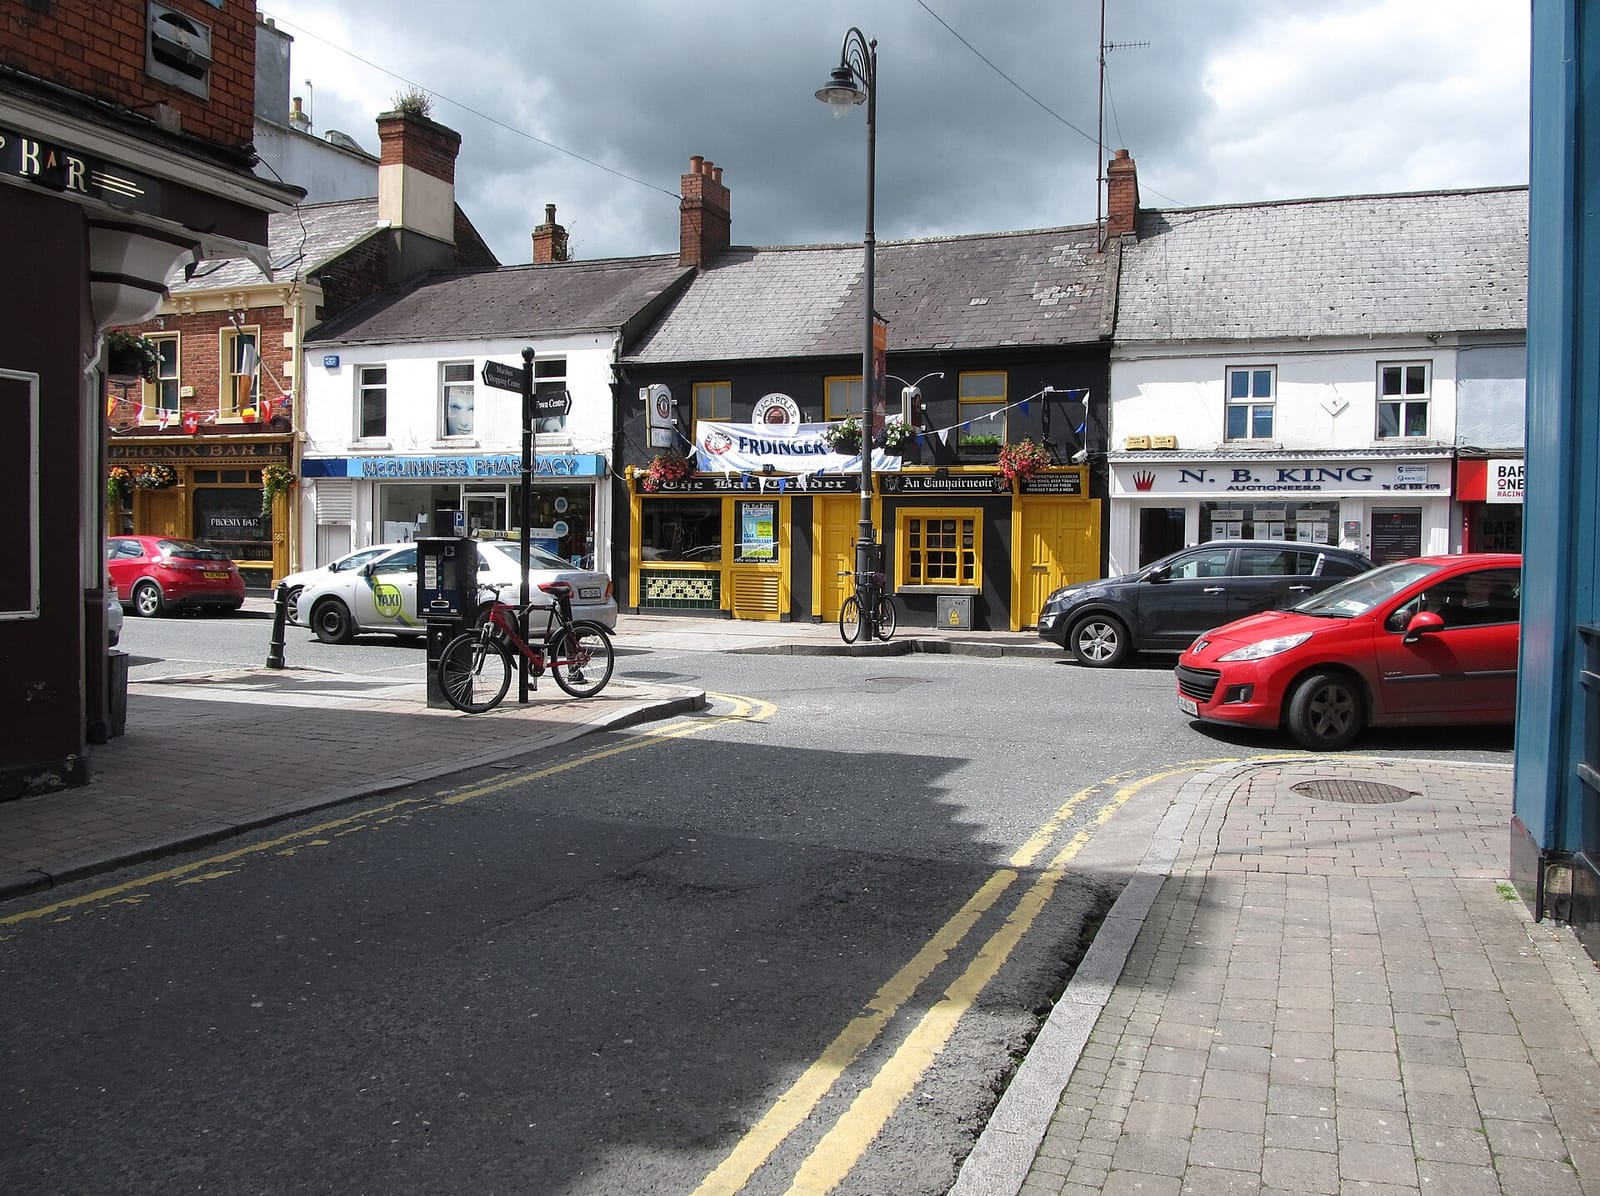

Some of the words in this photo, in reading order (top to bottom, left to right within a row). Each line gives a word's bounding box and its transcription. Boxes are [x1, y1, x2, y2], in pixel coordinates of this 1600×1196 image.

[548, 398, 565, 408] Centre
[209, 444, 255, 456] BAR
[269, 443, 283, 455] 15
[738, 436, 828, 456] ERDINGER
[1178, 469, 1215, 483] N.
[1230, 468, 1260, 483] B.
[1275, 467, 1374, 482] KING
[903, 477, 920, 488] An
[242, 518, 259, 527] BAR
[455, 512, 463, 526] P
[1483, 521, 1516, 535] BAR
[377, 594, 400, 607] TAXI
